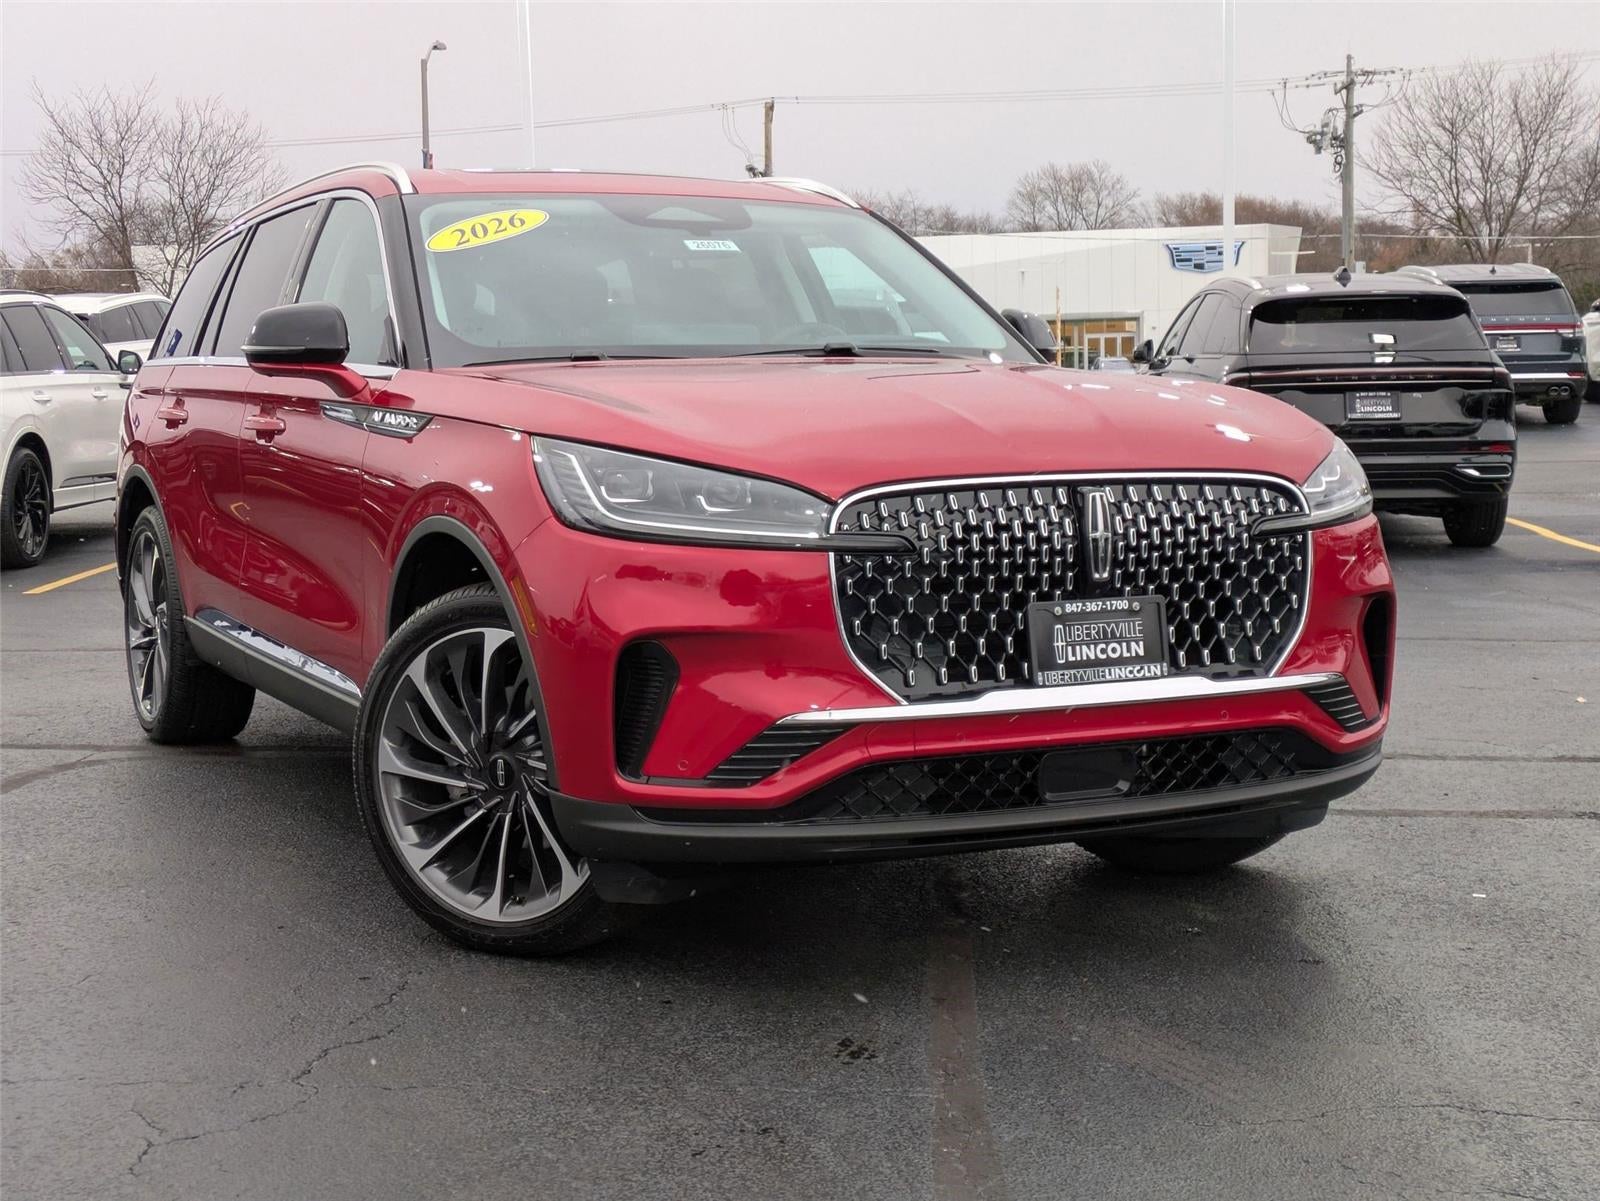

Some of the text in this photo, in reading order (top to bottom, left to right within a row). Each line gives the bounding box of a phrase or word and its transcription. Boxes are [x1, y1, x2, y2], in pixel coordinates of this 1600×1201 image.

[451, 212, 526, 246] 2026
[1361, 405, 1393, 413] LINCOLN
[1065, 600, 1129, 613] 847-367-1700
[1066, 621, 1144, 641] LIBERTYVILLE
[1067, 641, 1145, 662] LINCOLN
